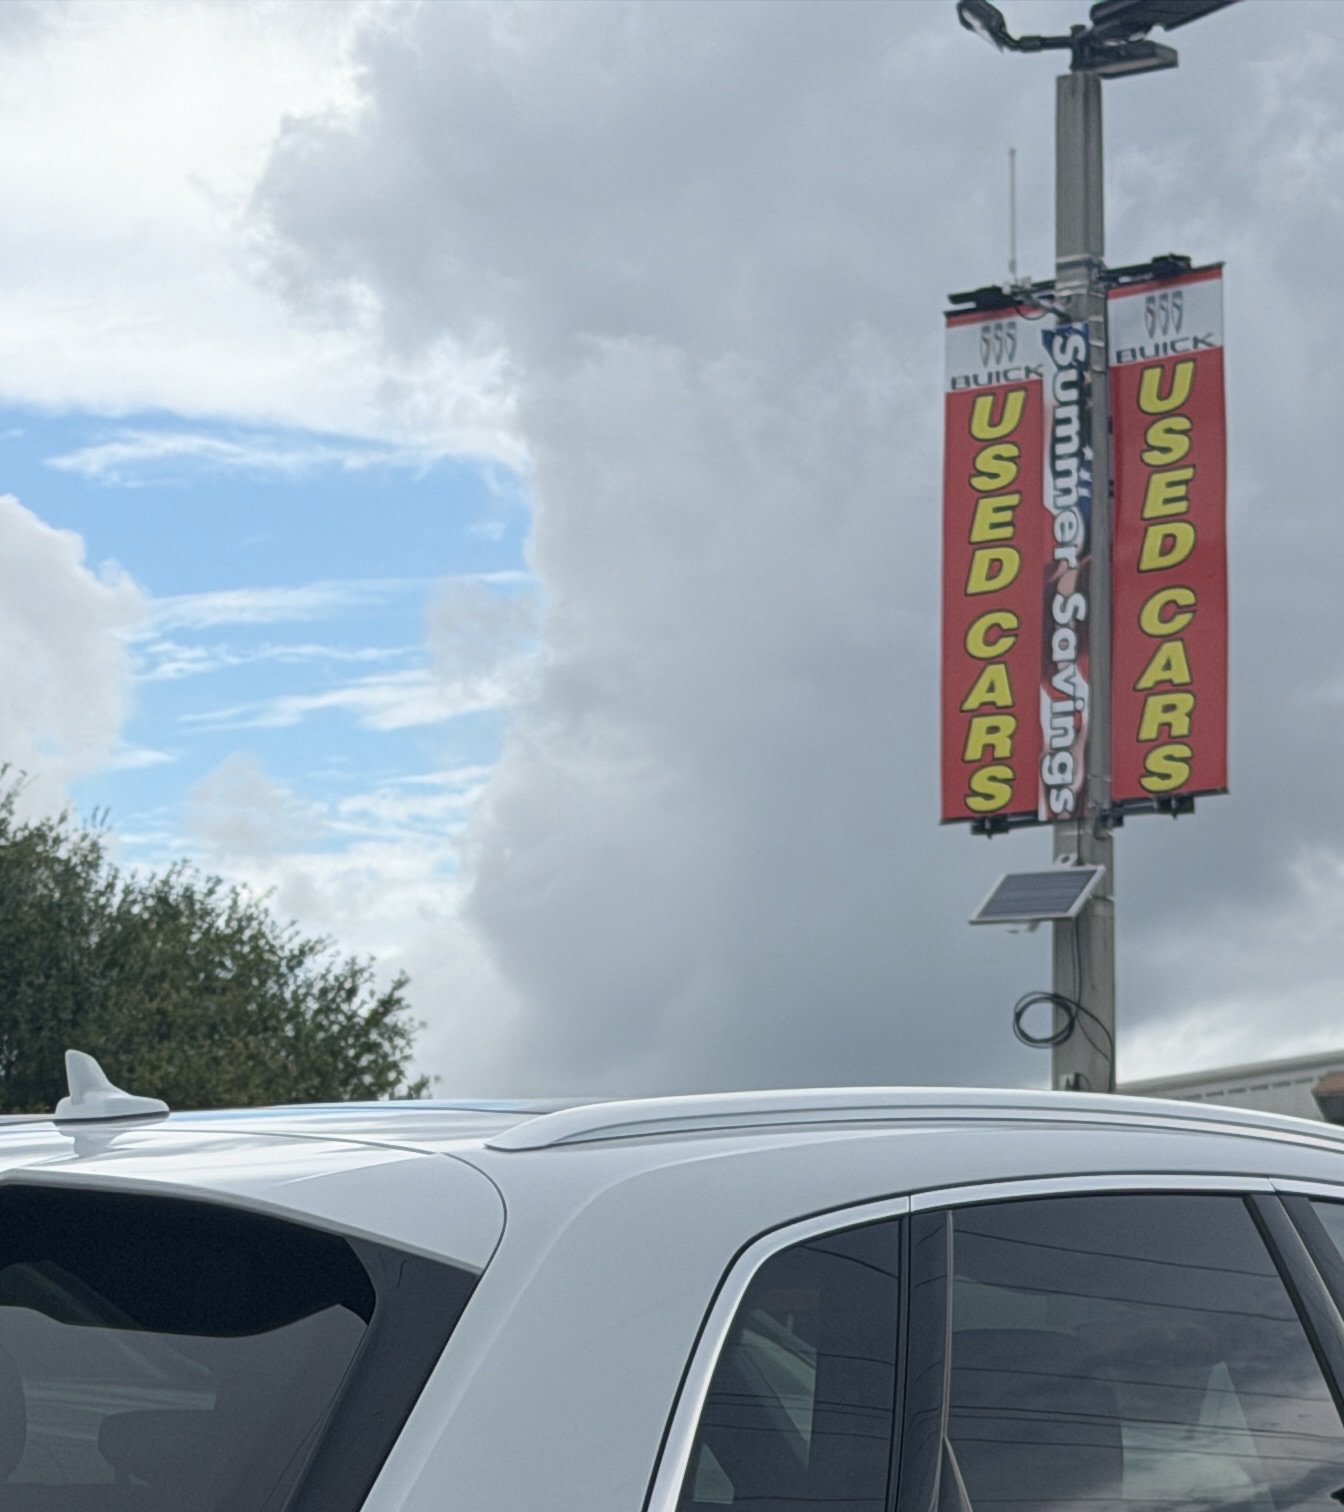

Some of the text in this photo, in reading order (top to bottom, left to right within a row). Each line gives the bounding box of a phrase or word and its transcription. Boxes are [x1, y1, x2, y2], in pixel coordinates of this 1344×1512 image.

[951, 363, 1043, 390] BUICK
[1116, 332, 1214, 364] BUICK
[960, 387, 1027, 814] USED CARS
[1041, 332, 1087, 814] Summer Savings
[1133, 359, 1198, 793] USED CARS
